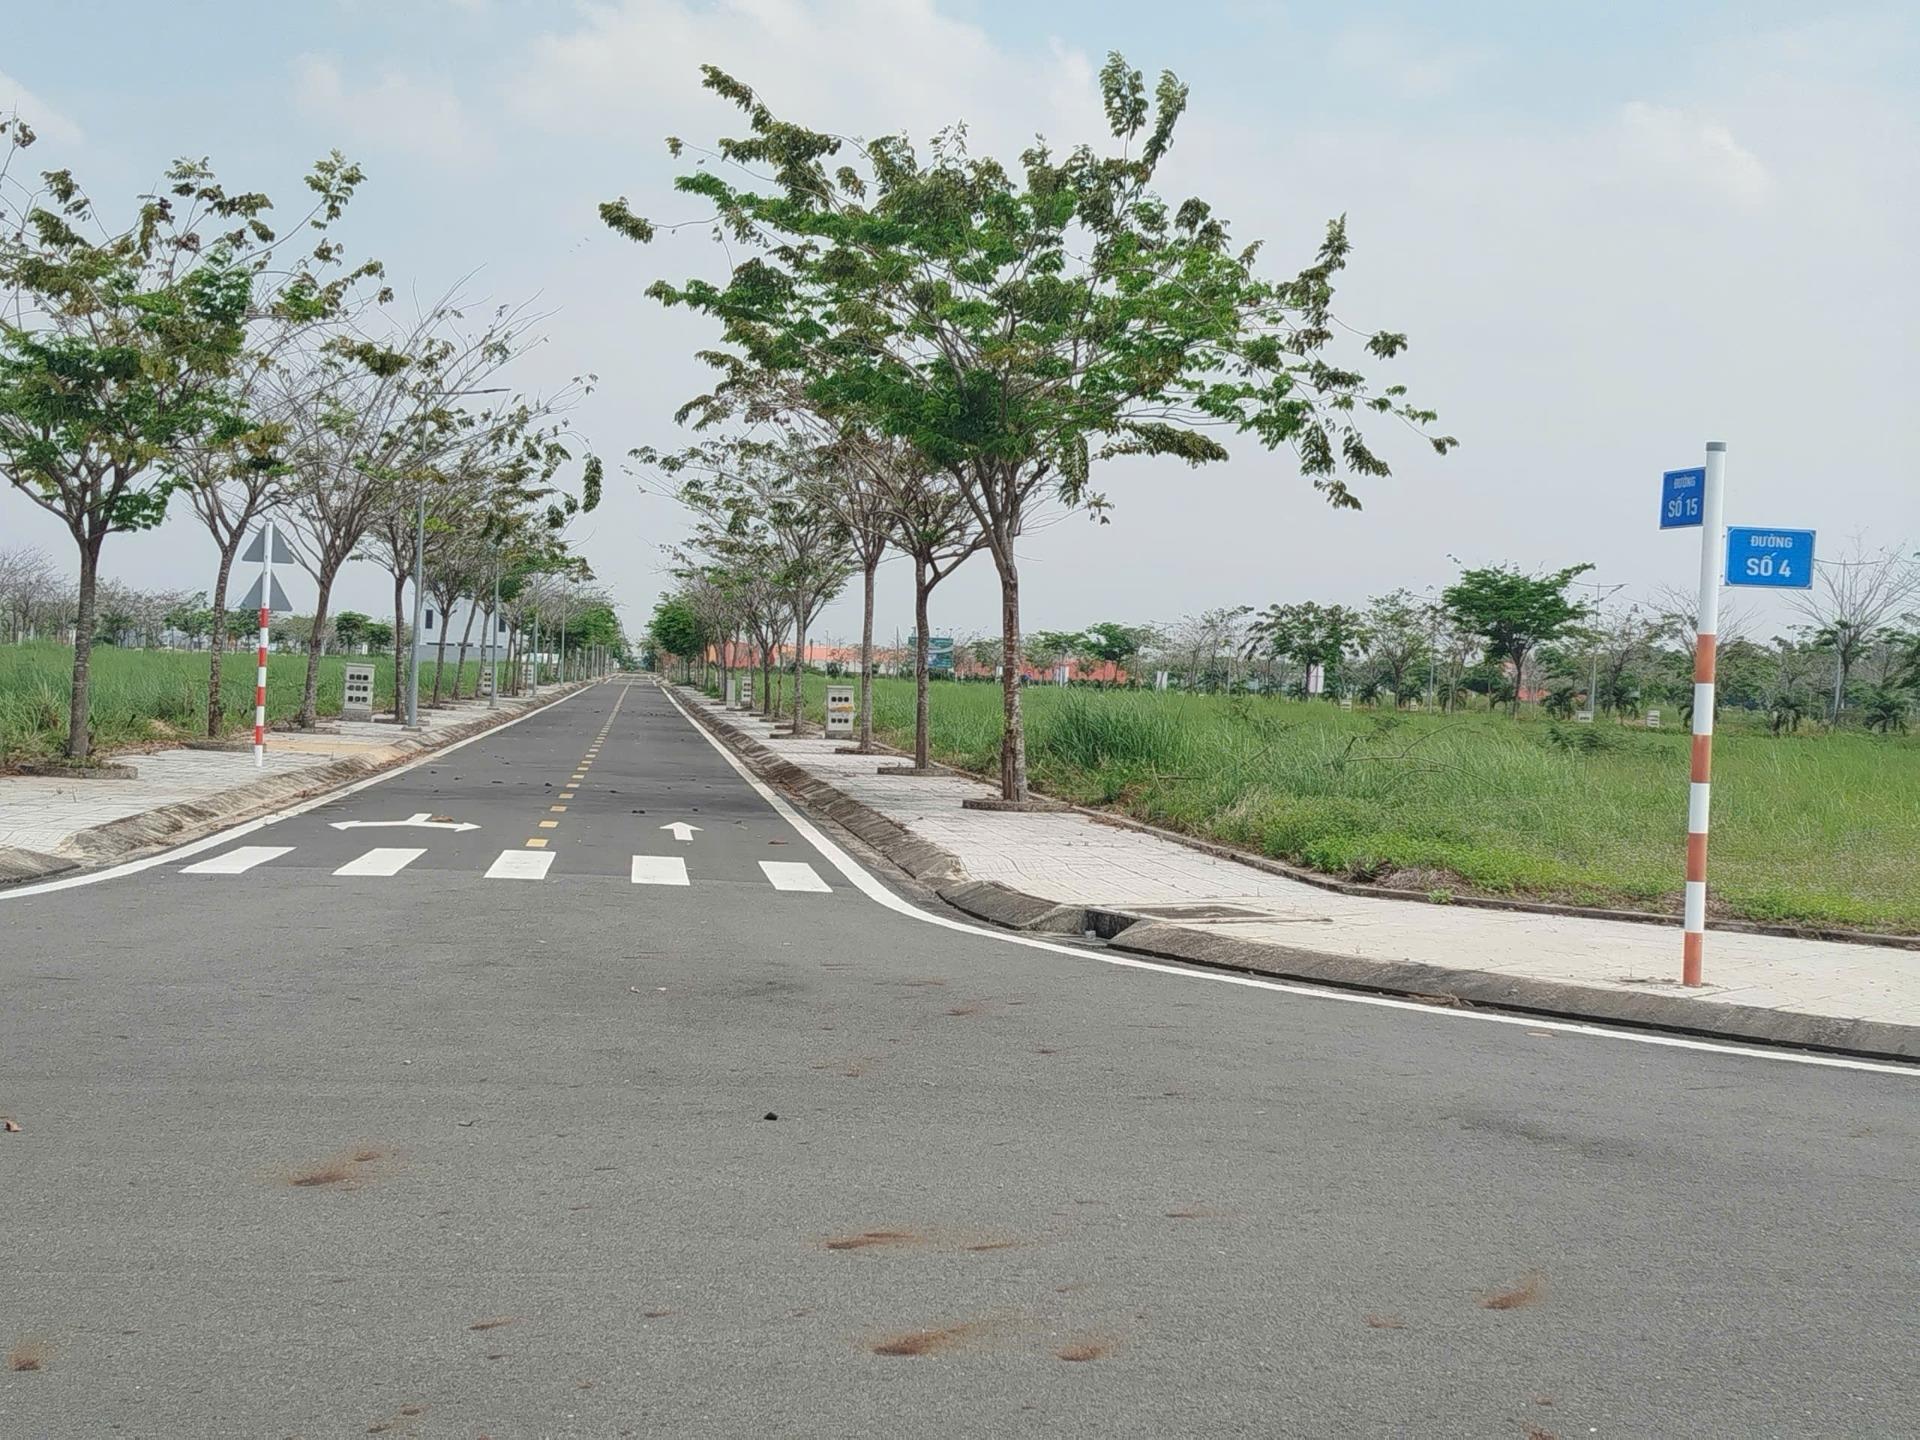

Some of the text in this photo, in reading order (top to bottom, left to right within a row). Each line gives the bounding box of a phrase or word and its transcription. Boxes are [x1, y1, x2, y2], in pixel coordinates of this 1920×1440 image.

[1668, 493, 1698, 518] SỐ 15
[1751, 533, 1793, 549] ĐƯỜNG
[1746, 552, 1792, 578] SỐ 4
